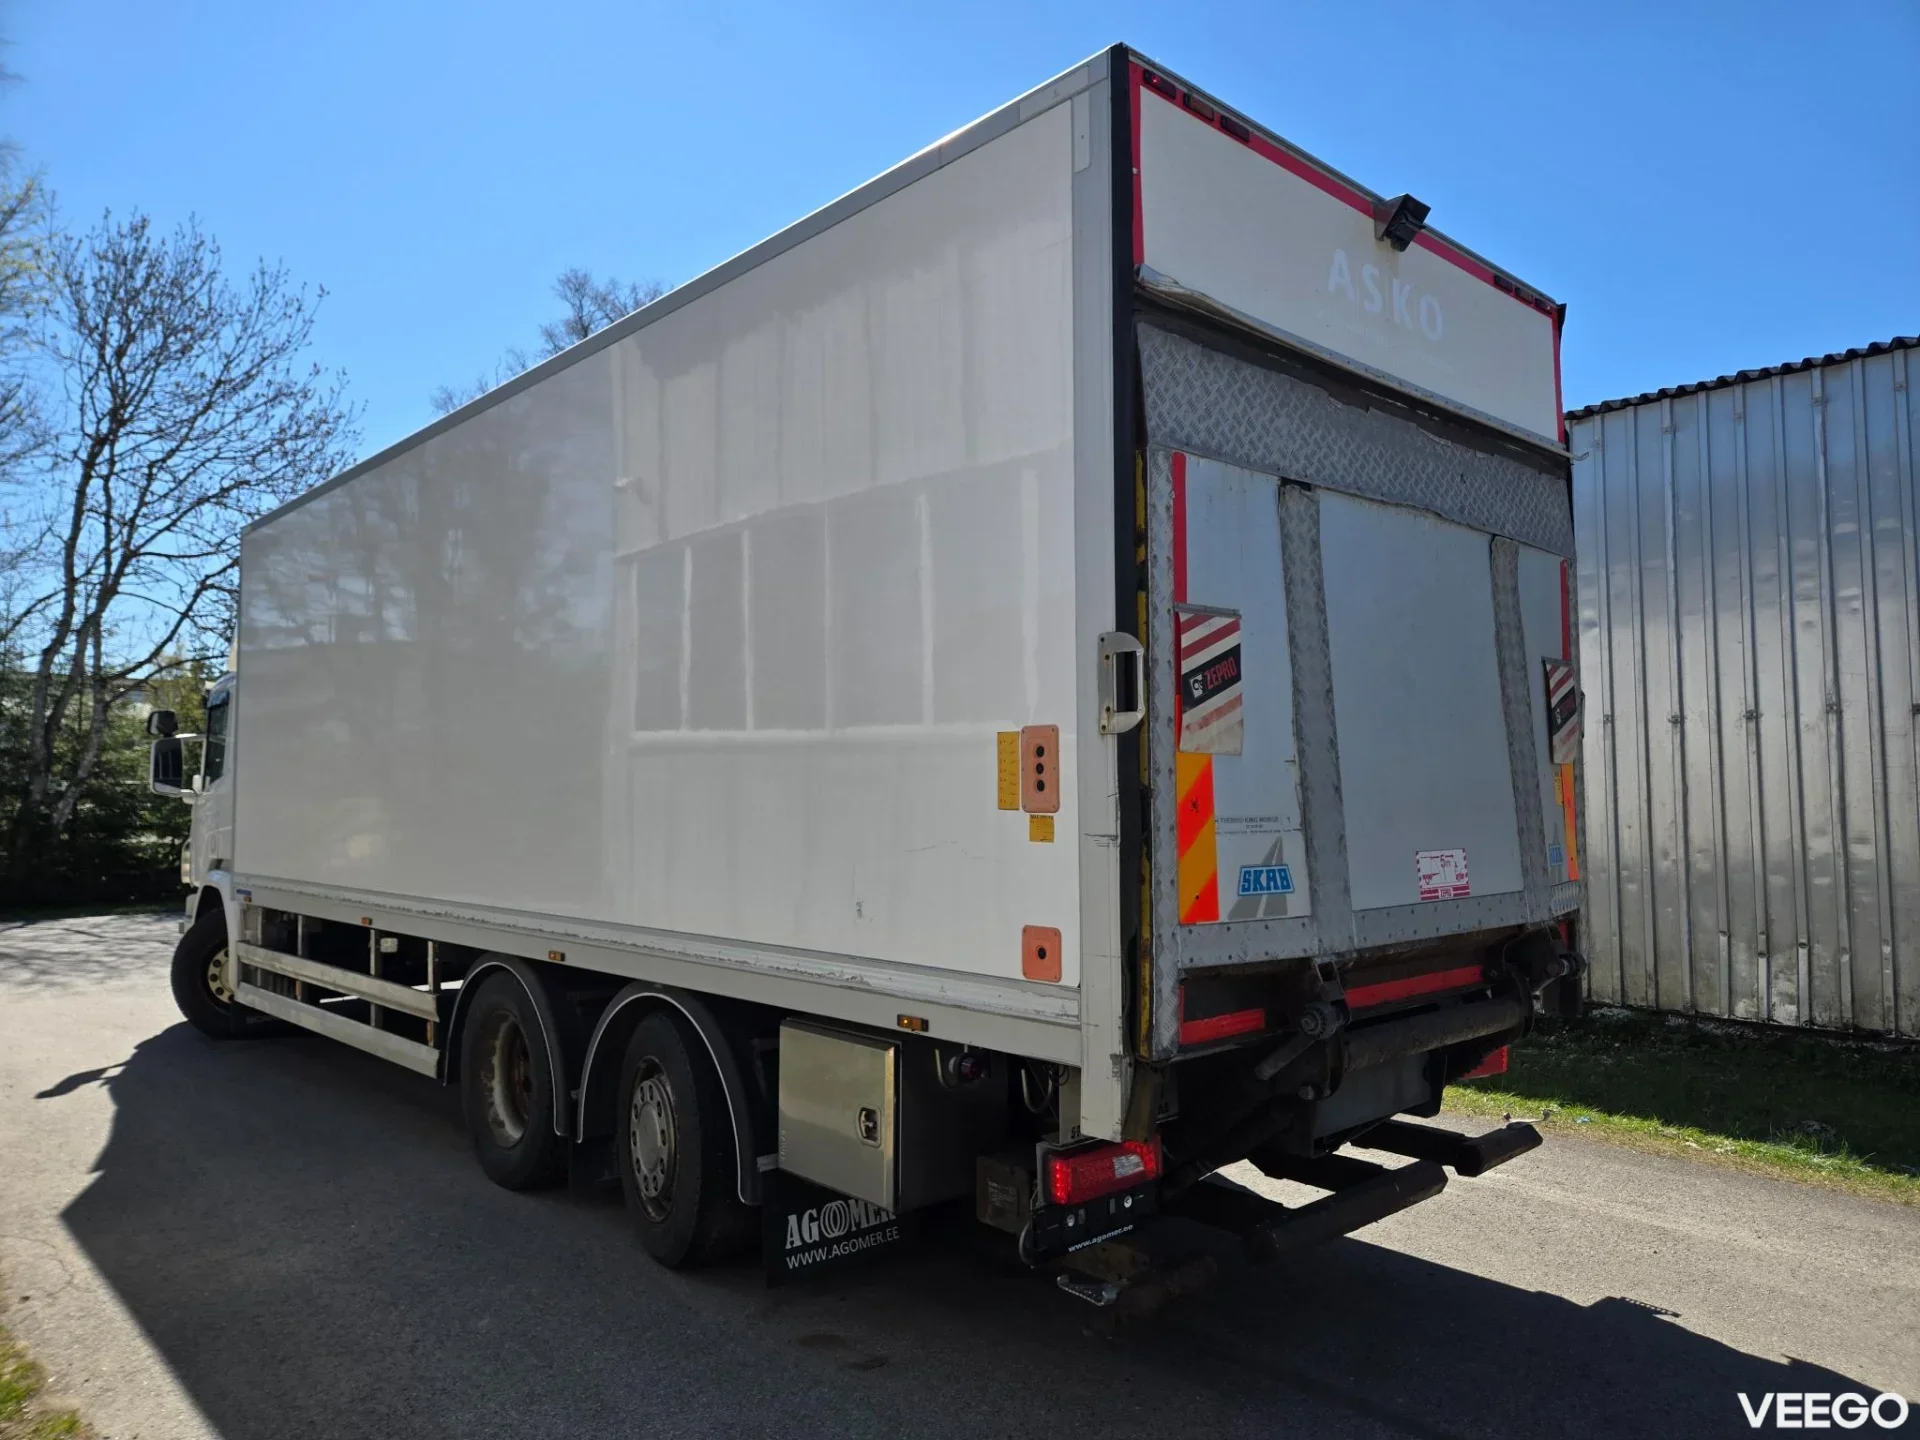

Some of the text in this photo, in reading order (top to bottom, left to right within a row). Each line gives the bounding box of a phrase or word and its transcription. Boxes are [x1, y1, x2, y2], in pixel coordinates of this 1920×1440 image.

[1327, 247, 1444, 342] ASKO
[1204, 657, 1237, 690] ZEPRO
[1245, 816, 1259, 824] KING
[1241, 868, 1292, 893] SKAB
[786, 1226, 900, 1270] WWW.AGOMER.EE
[1068, 1224, 1134, 1253] www.agomer.ee
